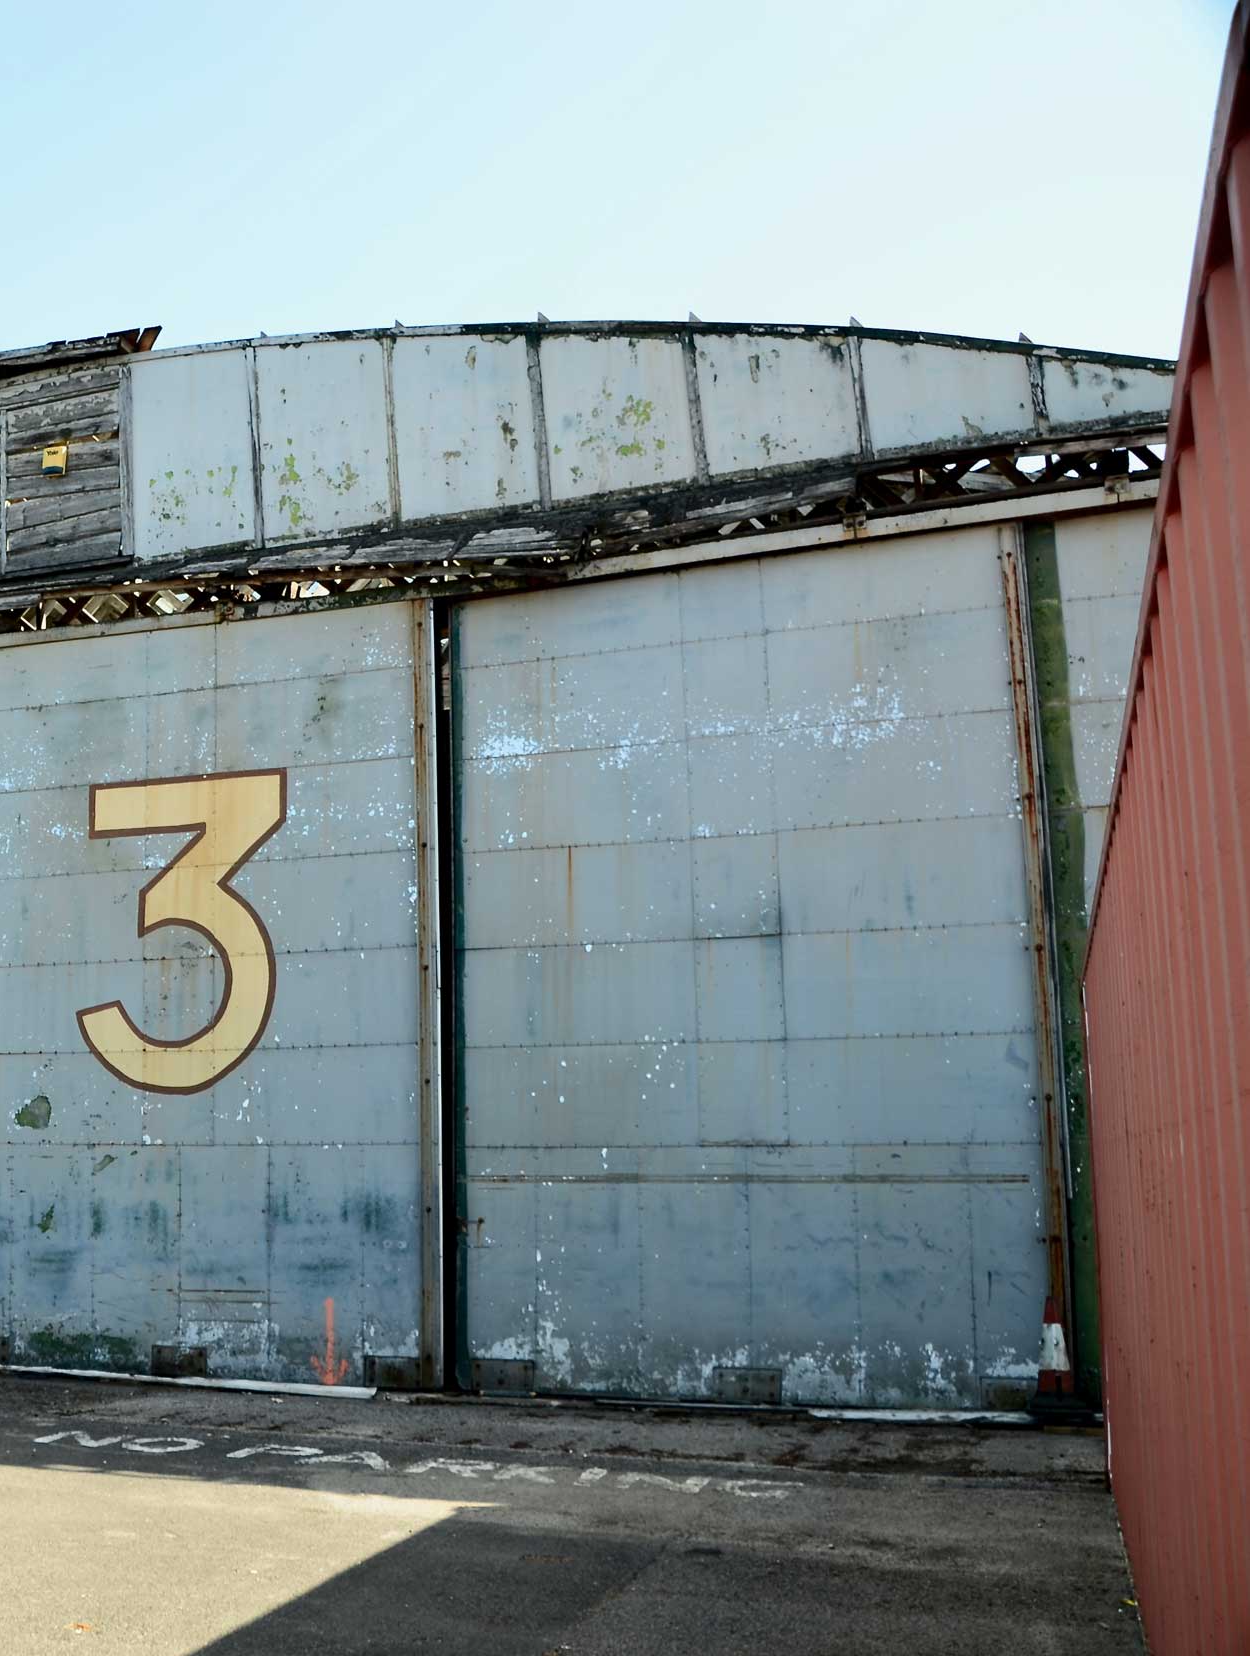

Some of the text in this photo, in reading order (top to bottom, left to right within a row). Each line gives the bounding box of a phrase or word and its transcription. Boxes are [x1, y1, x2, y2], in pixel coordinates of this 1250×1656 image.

[76, 767, 287, 1095] 3
[34, 1430, 804, 1499] NO PARKING
